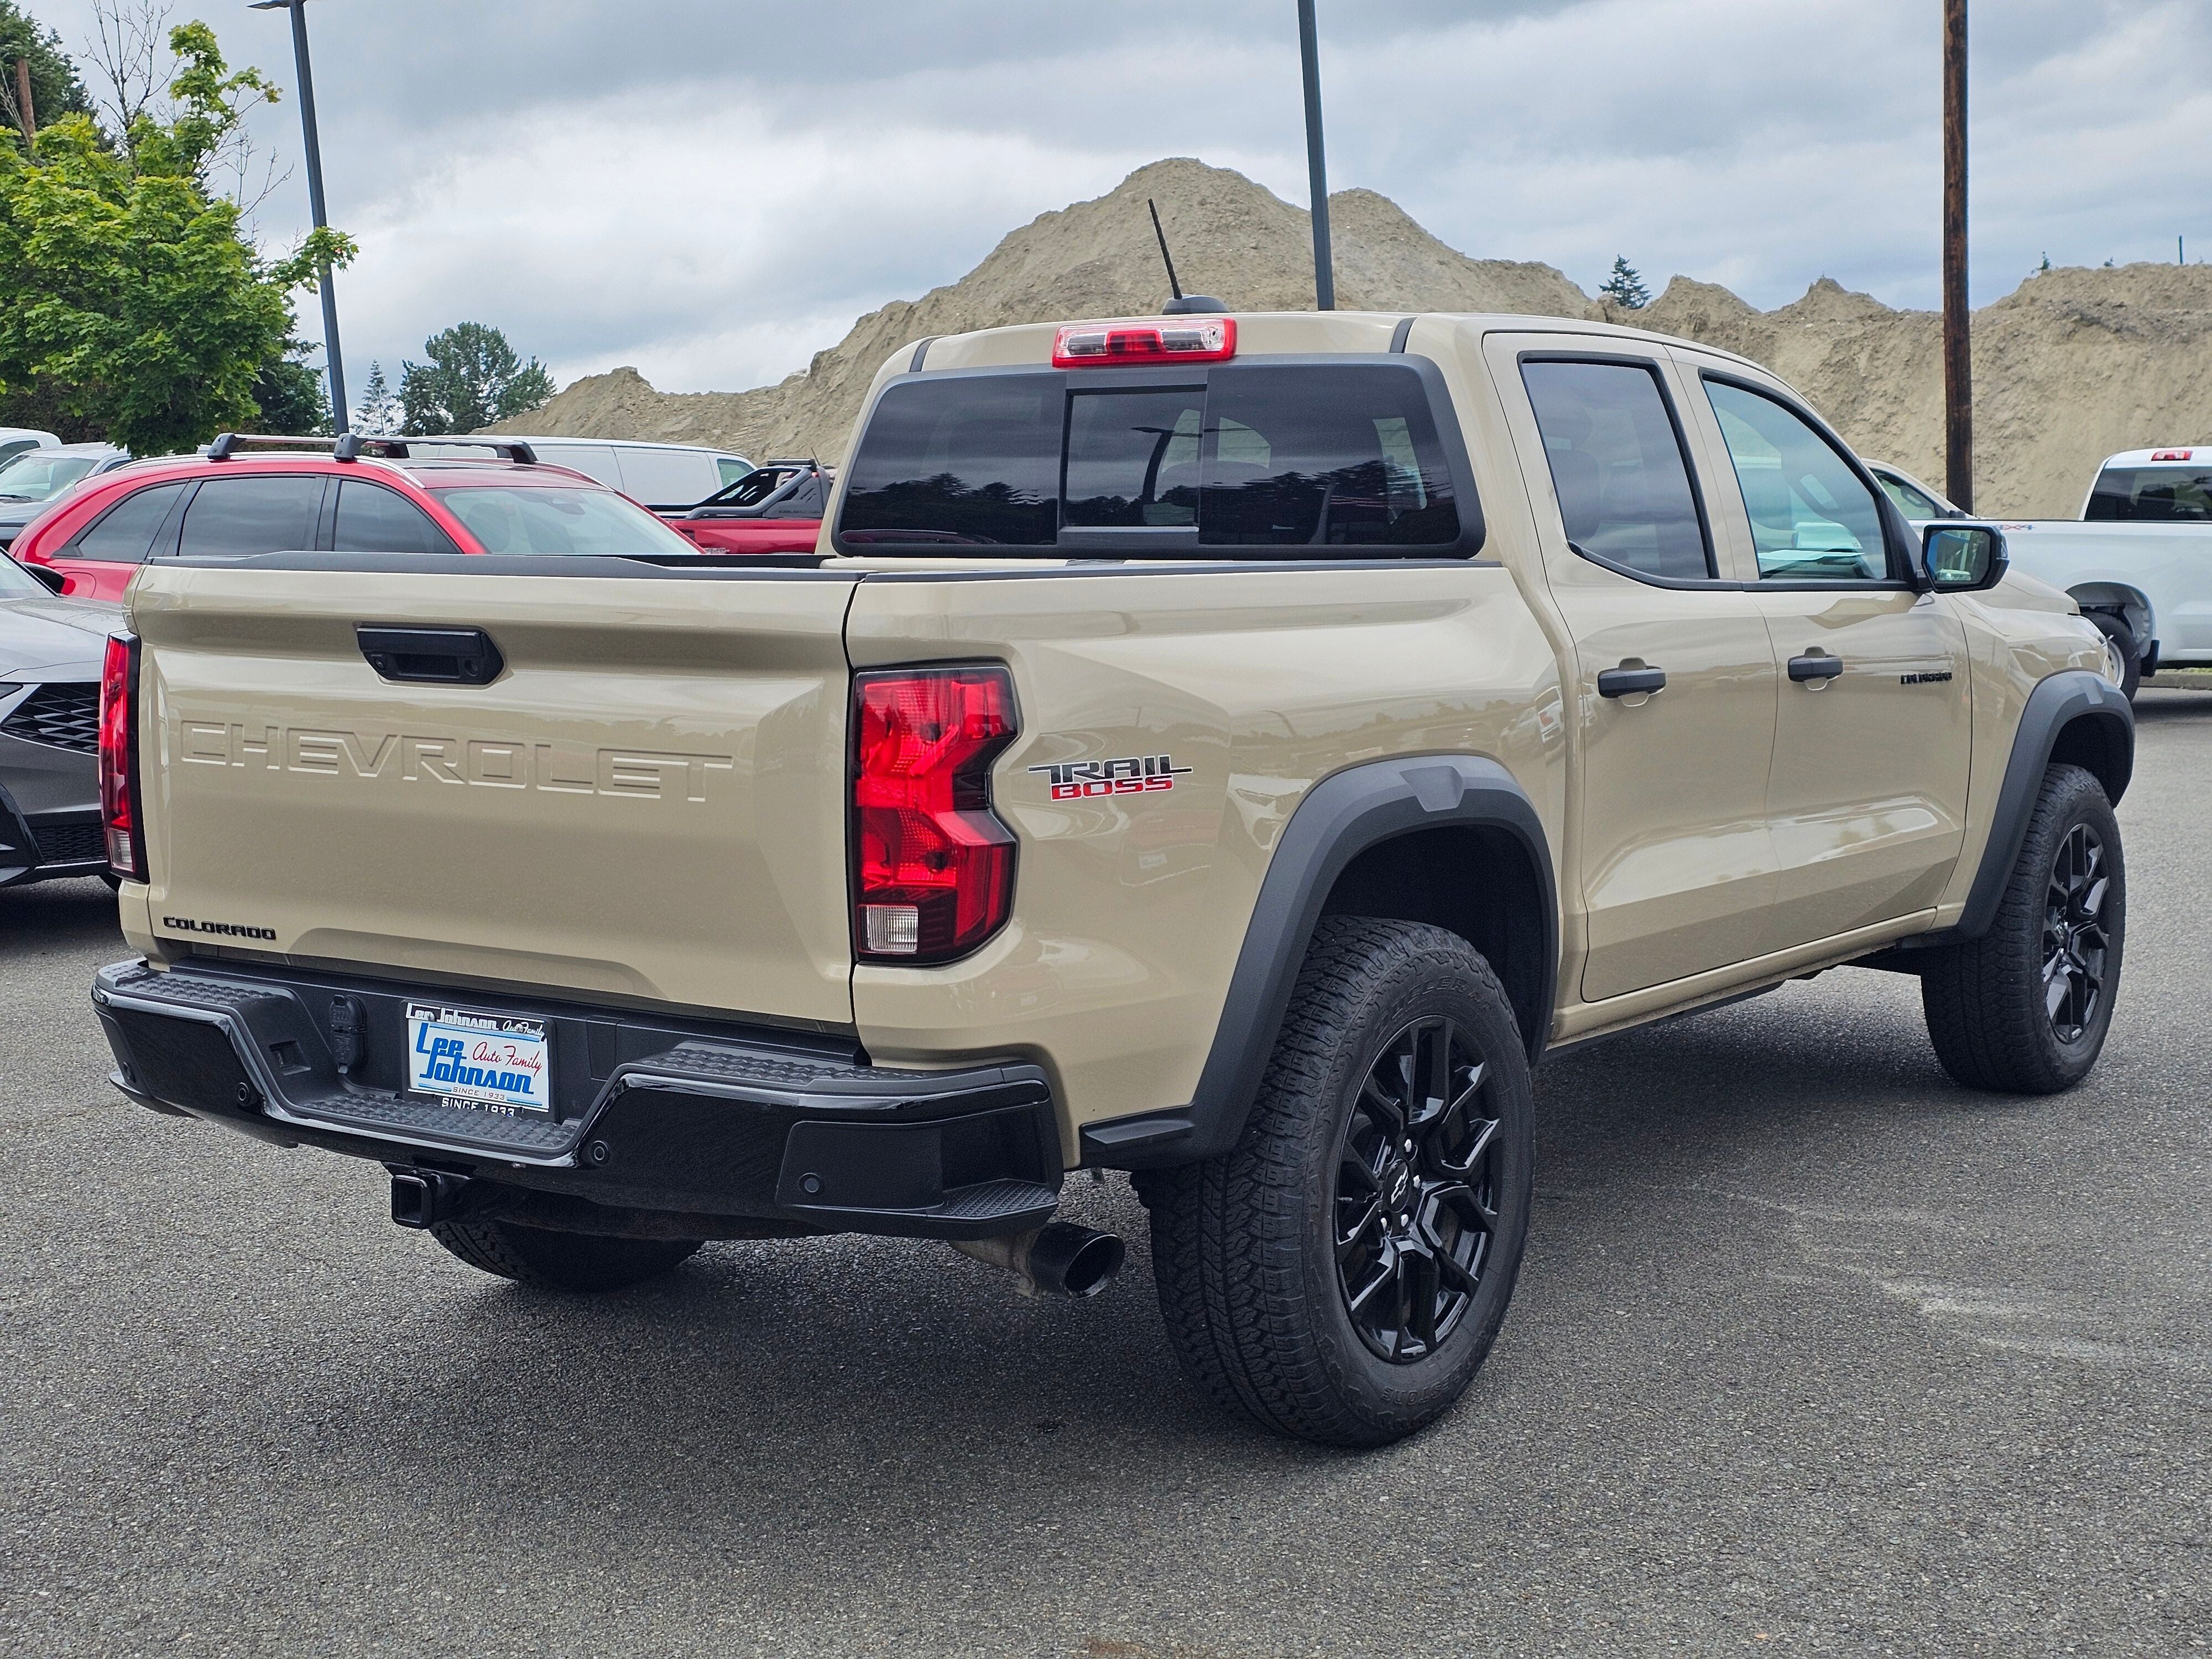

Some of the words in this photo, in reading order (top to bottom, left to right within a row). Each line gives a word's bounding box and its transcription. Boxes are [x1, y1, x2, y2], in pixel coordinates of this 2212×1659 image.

[181, 720, 733, 802] CHEVROLET
[1027, 754, 1193, 784] TRAIL
[1051, 774, 1173, 801] BOSS
[163, 916, 276, 940] COLORADO
[416, 1022, 467, 1058] Lee
[436, 1008, 499, 1030] Johnson
[520, 1021, 545, 1040] Family
[419, 1052, 534, 1095] Johnson
[472, 1041, 502, 1063] Auto
[503, 1045, 542, 1078] Family
[452, 1087, 479, 1096] SINCE
[484, 1091, 505, 1100] 1933
